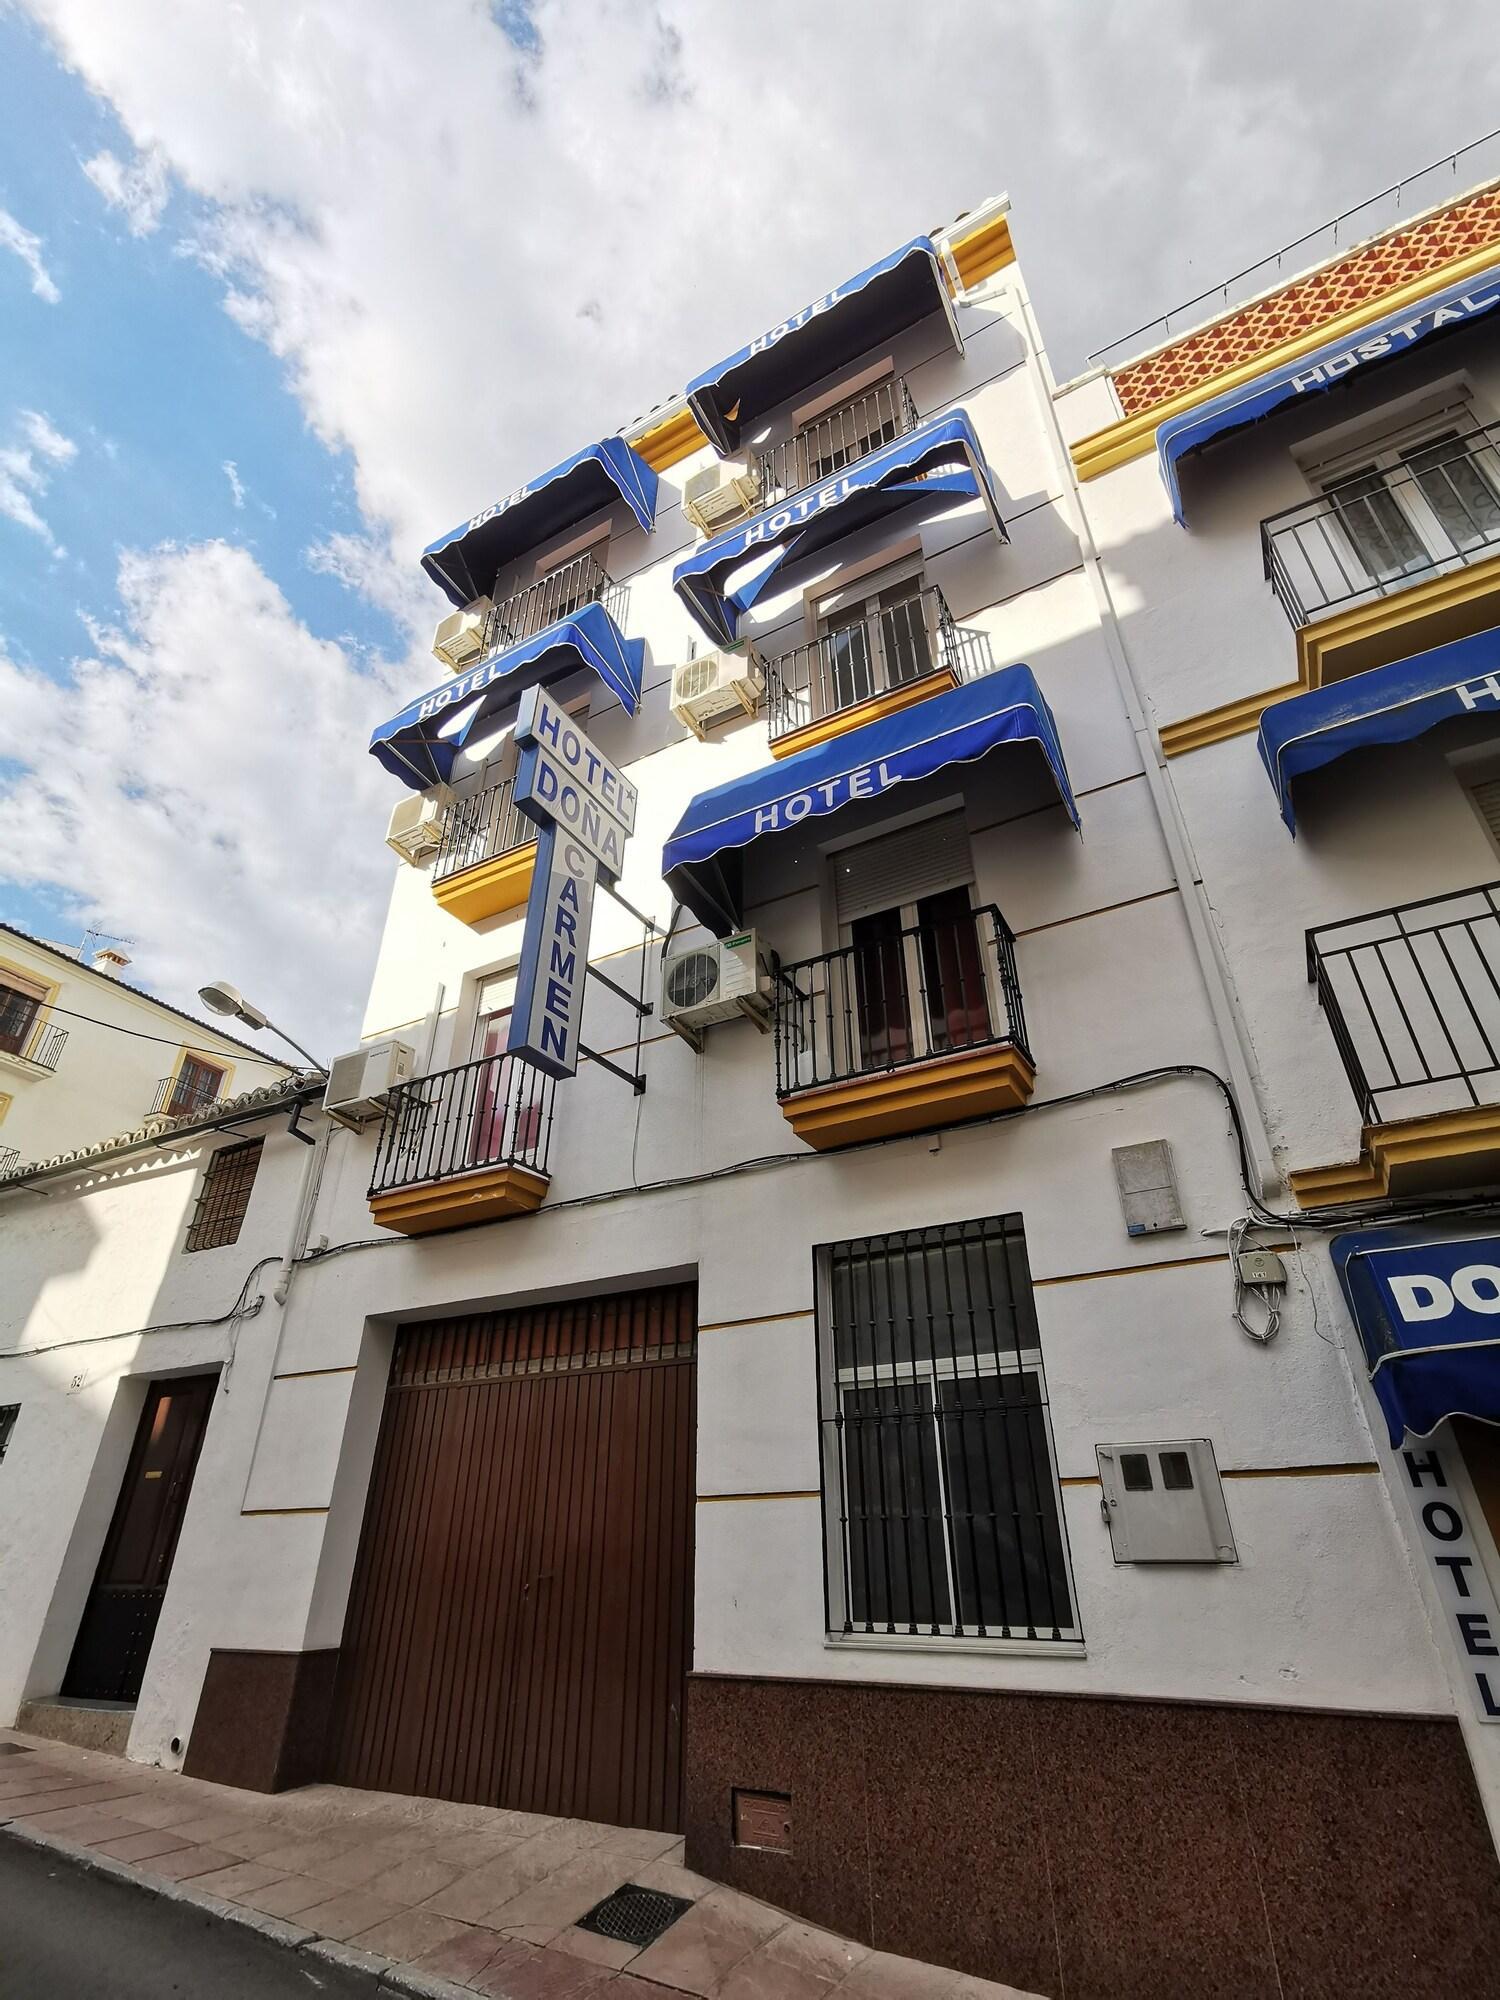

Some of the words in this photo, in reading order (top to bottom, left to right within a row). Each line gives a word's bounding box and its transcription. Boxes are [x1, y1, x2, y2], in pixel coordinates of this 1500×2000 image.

[751, 291, 847, 356] HOTEL
[1291, 295, 1500, 392] HOSTAL
[468, 486, 533, 531] HOTEL
[745, 479, 860, 546] HOTEL
[419, 665, 501, 718] HOTEL
[539, 704, 630, 822] HOTEL
[755, 763, 902, 833] HOTEL
[537, 760, 619, 866] DOÑA
[540, 844, 585, 1062] CARMEN
[1387, 1264, 1500, 1323] DO
[1402, 1450, 1500, 1716] HOTEL
